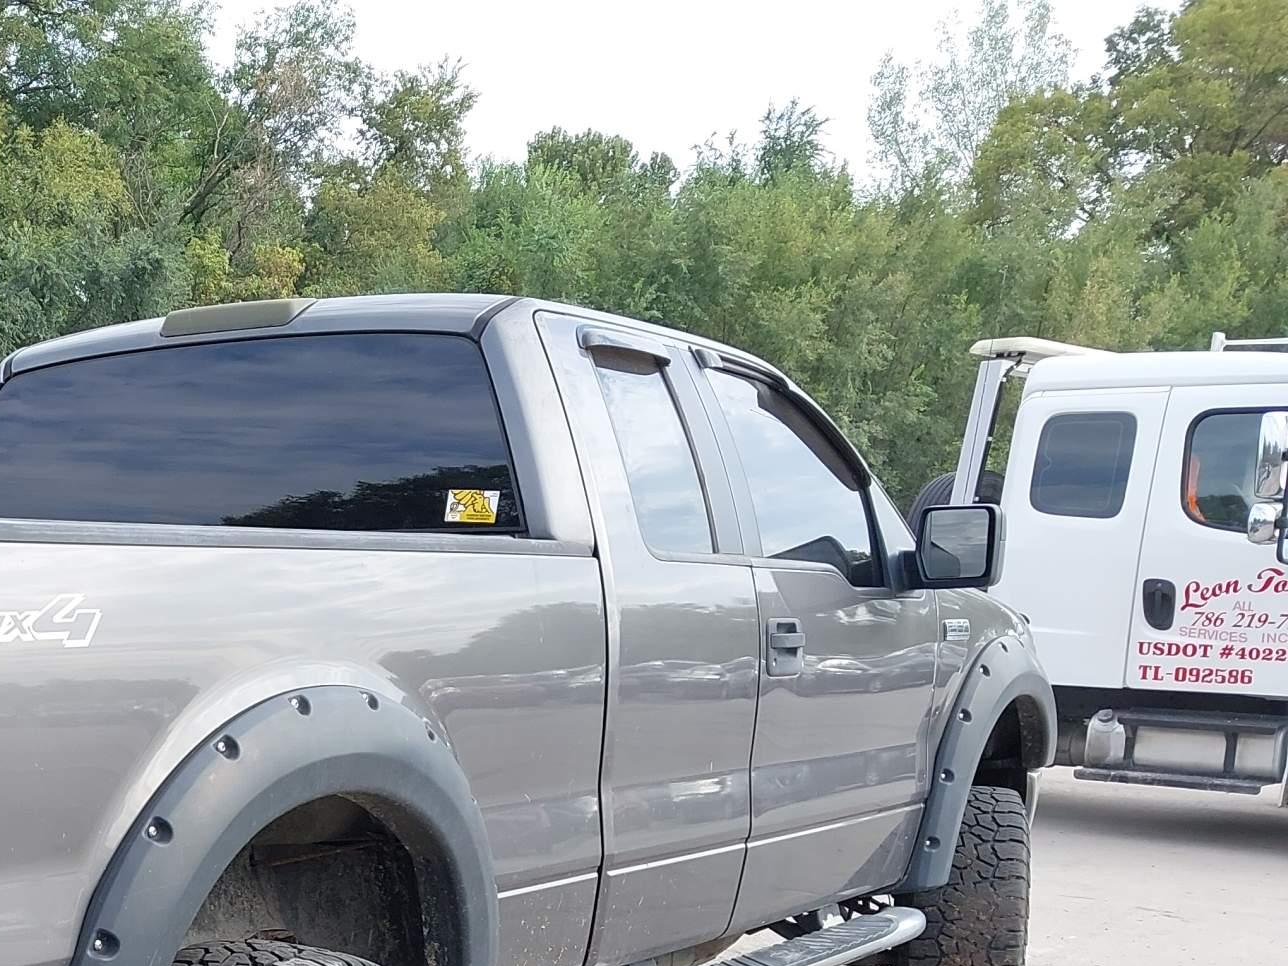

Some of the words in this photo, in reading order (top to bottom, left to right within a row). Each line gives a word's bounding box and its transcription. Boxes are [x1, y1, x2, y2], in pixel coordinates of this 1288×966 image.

[1180, 580, 1242, 611] Leon
[1232, 600, 1254, 612] ALL
[1191, 611, 1227, 628] 786
[1179, 626, 1248, 643] SERVICES
[1138, 641, 1213, 658] USDOT
[1219, 644, 1288, 662] #4022
[1139, 665, 1253, 685] TL-092586
